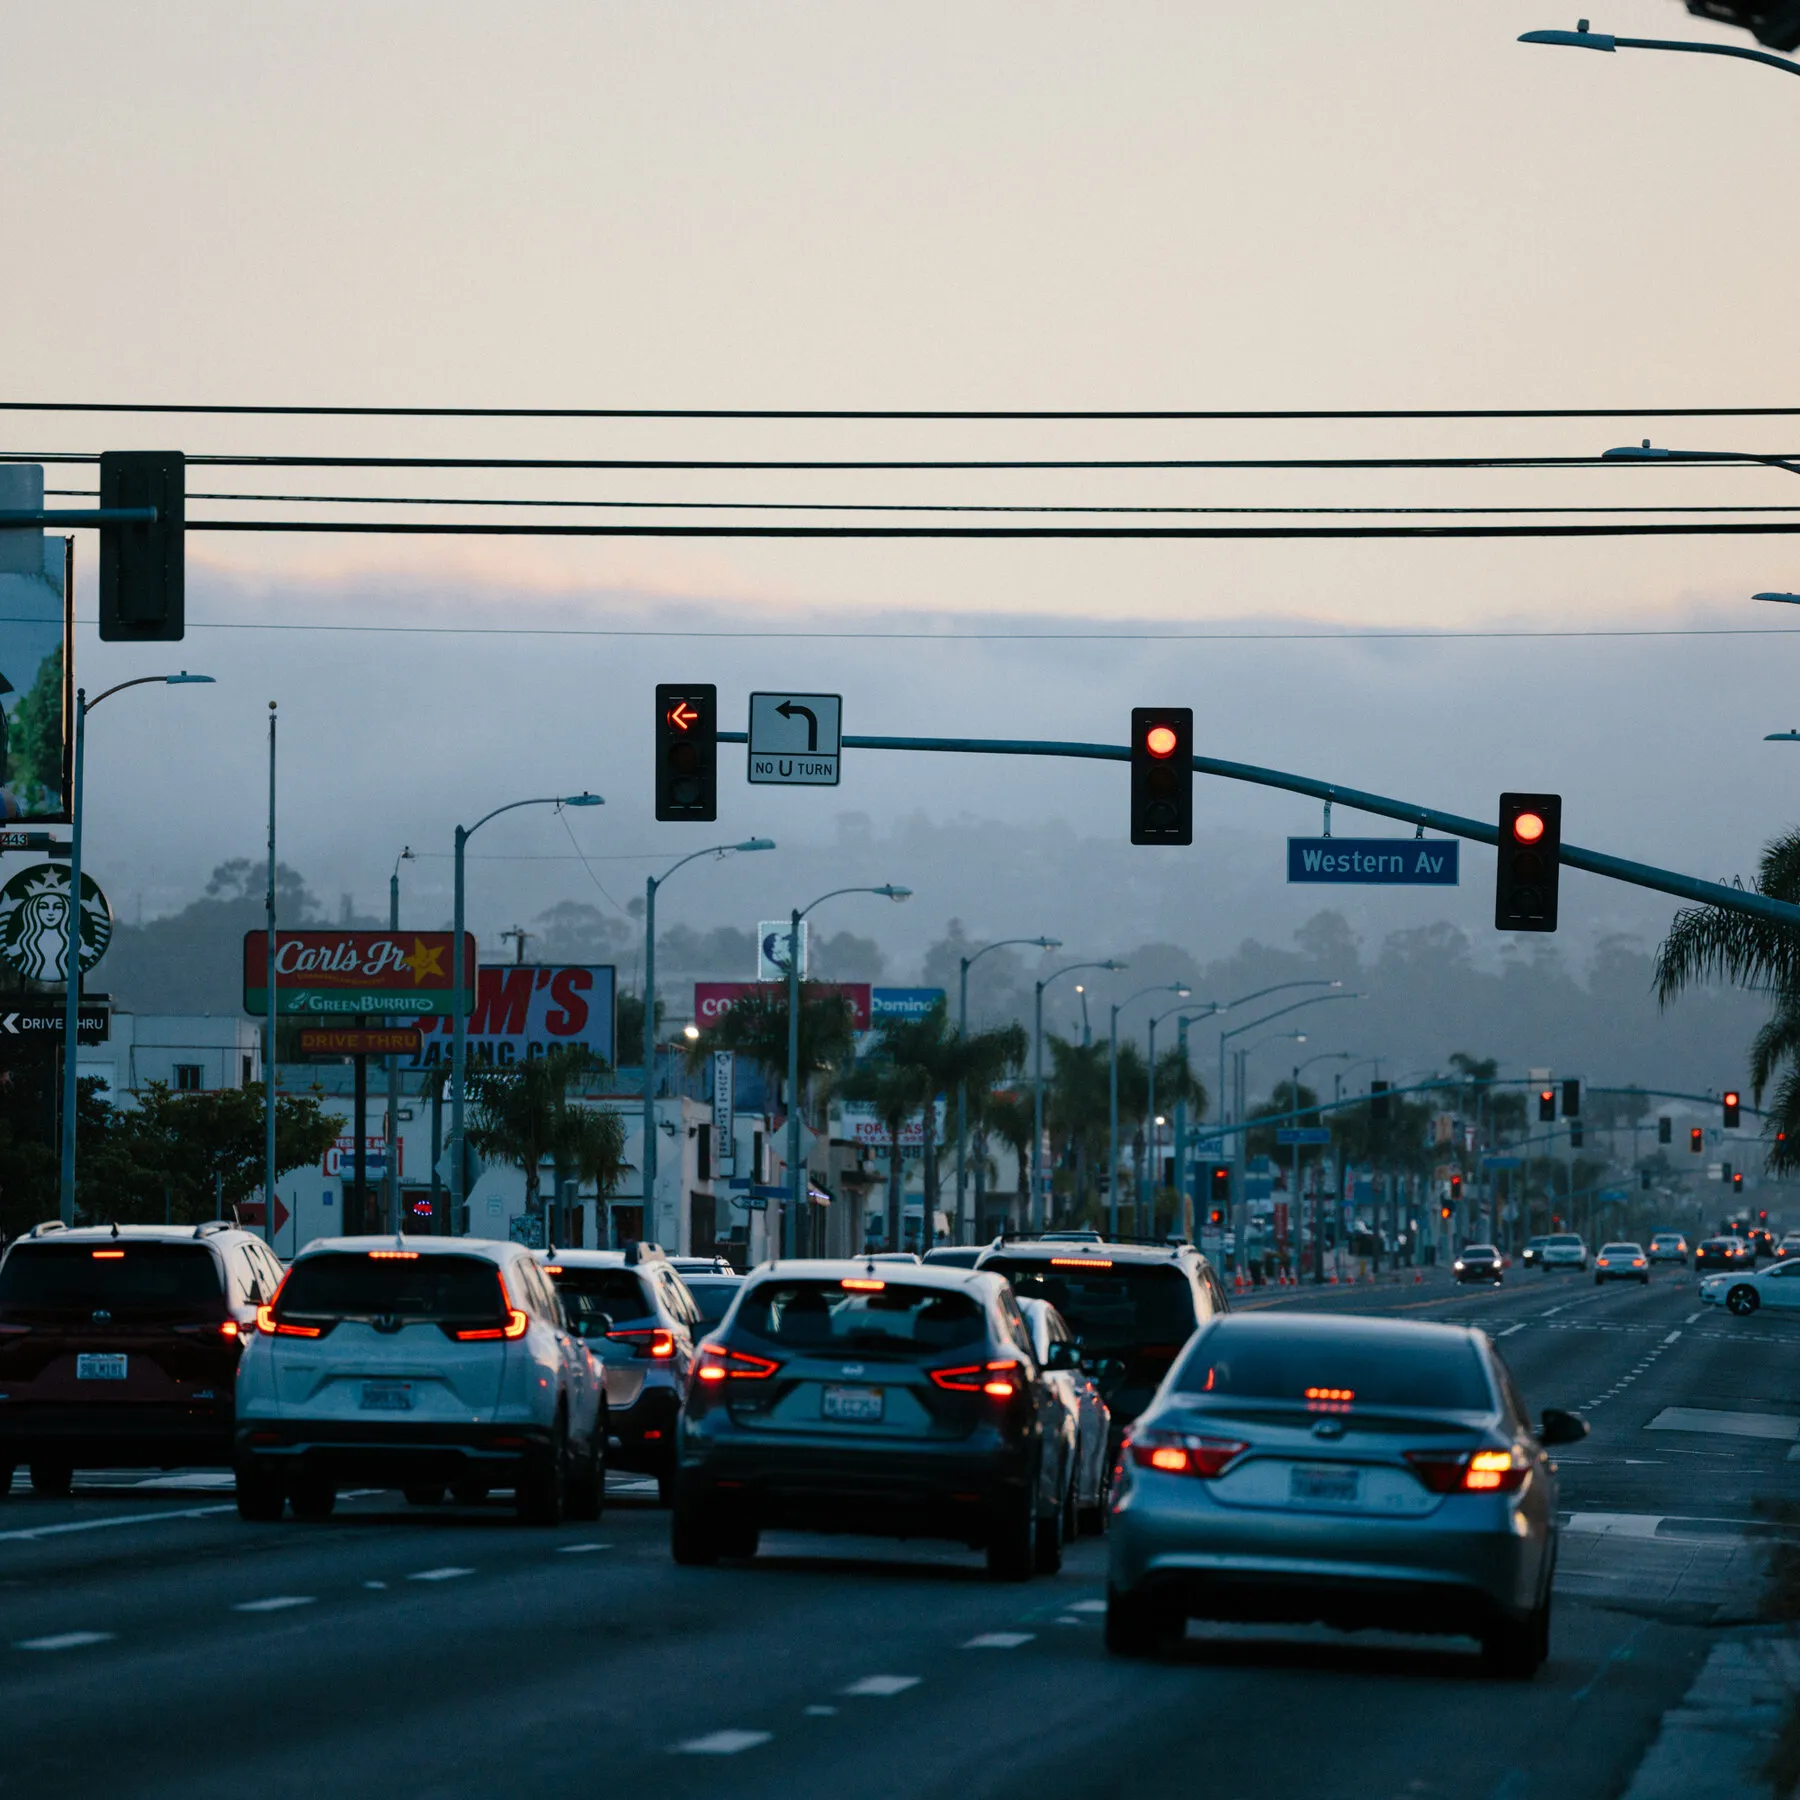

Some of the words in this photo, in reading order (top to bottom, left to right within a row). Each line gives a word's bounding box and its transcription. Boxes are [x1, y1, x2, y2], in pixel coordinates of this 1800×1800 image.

[756, 762, 773, 774] NO
[779, 760, 792, 777] U
[798, 764, 832, 776] TURN
[1302, 849, 1403, 873] Western
[1414, 851, 1444, 873] Av
[276, 940, 360, 975] Carl's
[362, 940, 411, 976] Jr.
[22, 1018, 63, 1030] DRIVE
[77, 1018, 104, 1031] HRU
[302, 1034, 358, 1048] DRIVE
[366, 1034, 417, 1048] THRU
[856, 1123, 882, 1134] FOR
